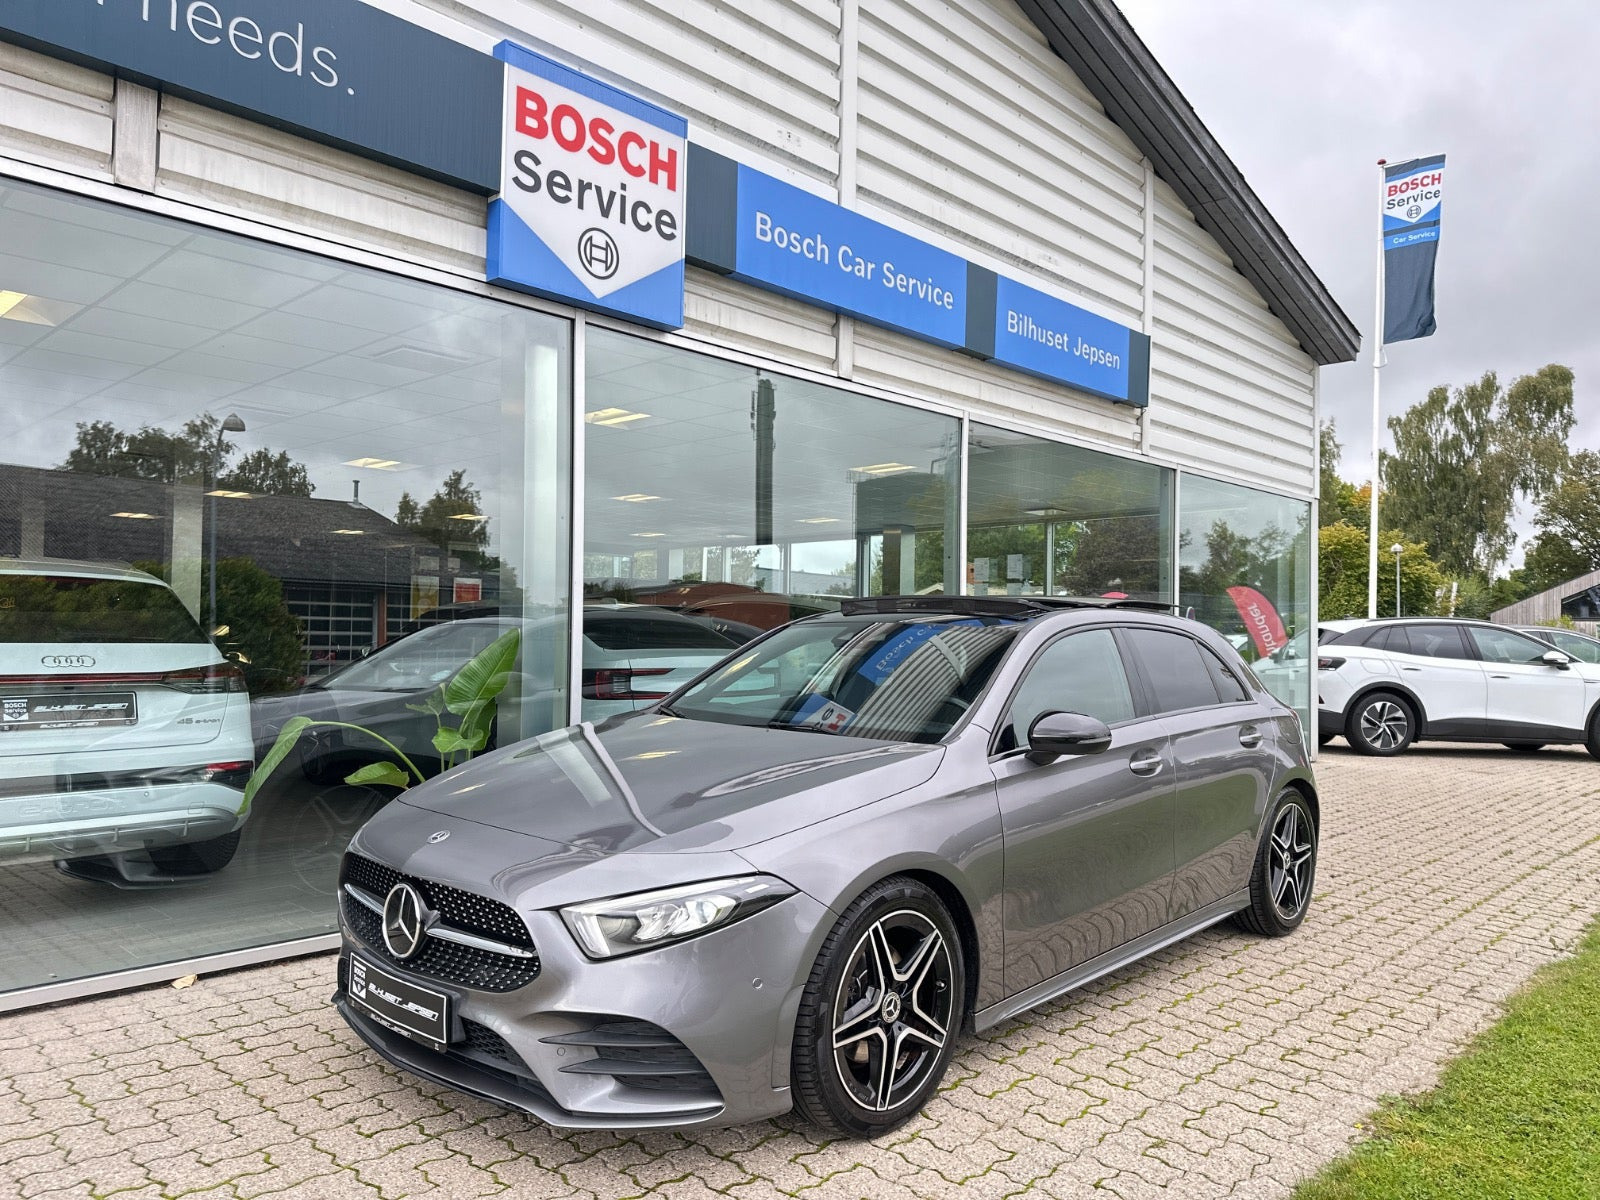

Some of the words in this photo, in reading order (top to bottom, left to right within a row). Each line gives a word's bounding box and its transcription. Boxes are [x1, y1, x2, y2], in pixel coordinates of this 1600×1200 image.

[515, 85, 677, 192] BOSCH
[512, 150, 677, 241] Service
[1386, 189, 1441, 210] Service
[1387, 172, 1442, 198] BOSCH
[755, 211, 829, 265] Bosch
[837, 245, 876, 280] Car
[882, 262, 954, 310] Service
[1393, 236, 1407, 244] Car
[1408, 230, 1436, 241] Service
[1007, 310, 1069, 352] Bilhuset
[1073, 336, 1120, 370] Jepsen
